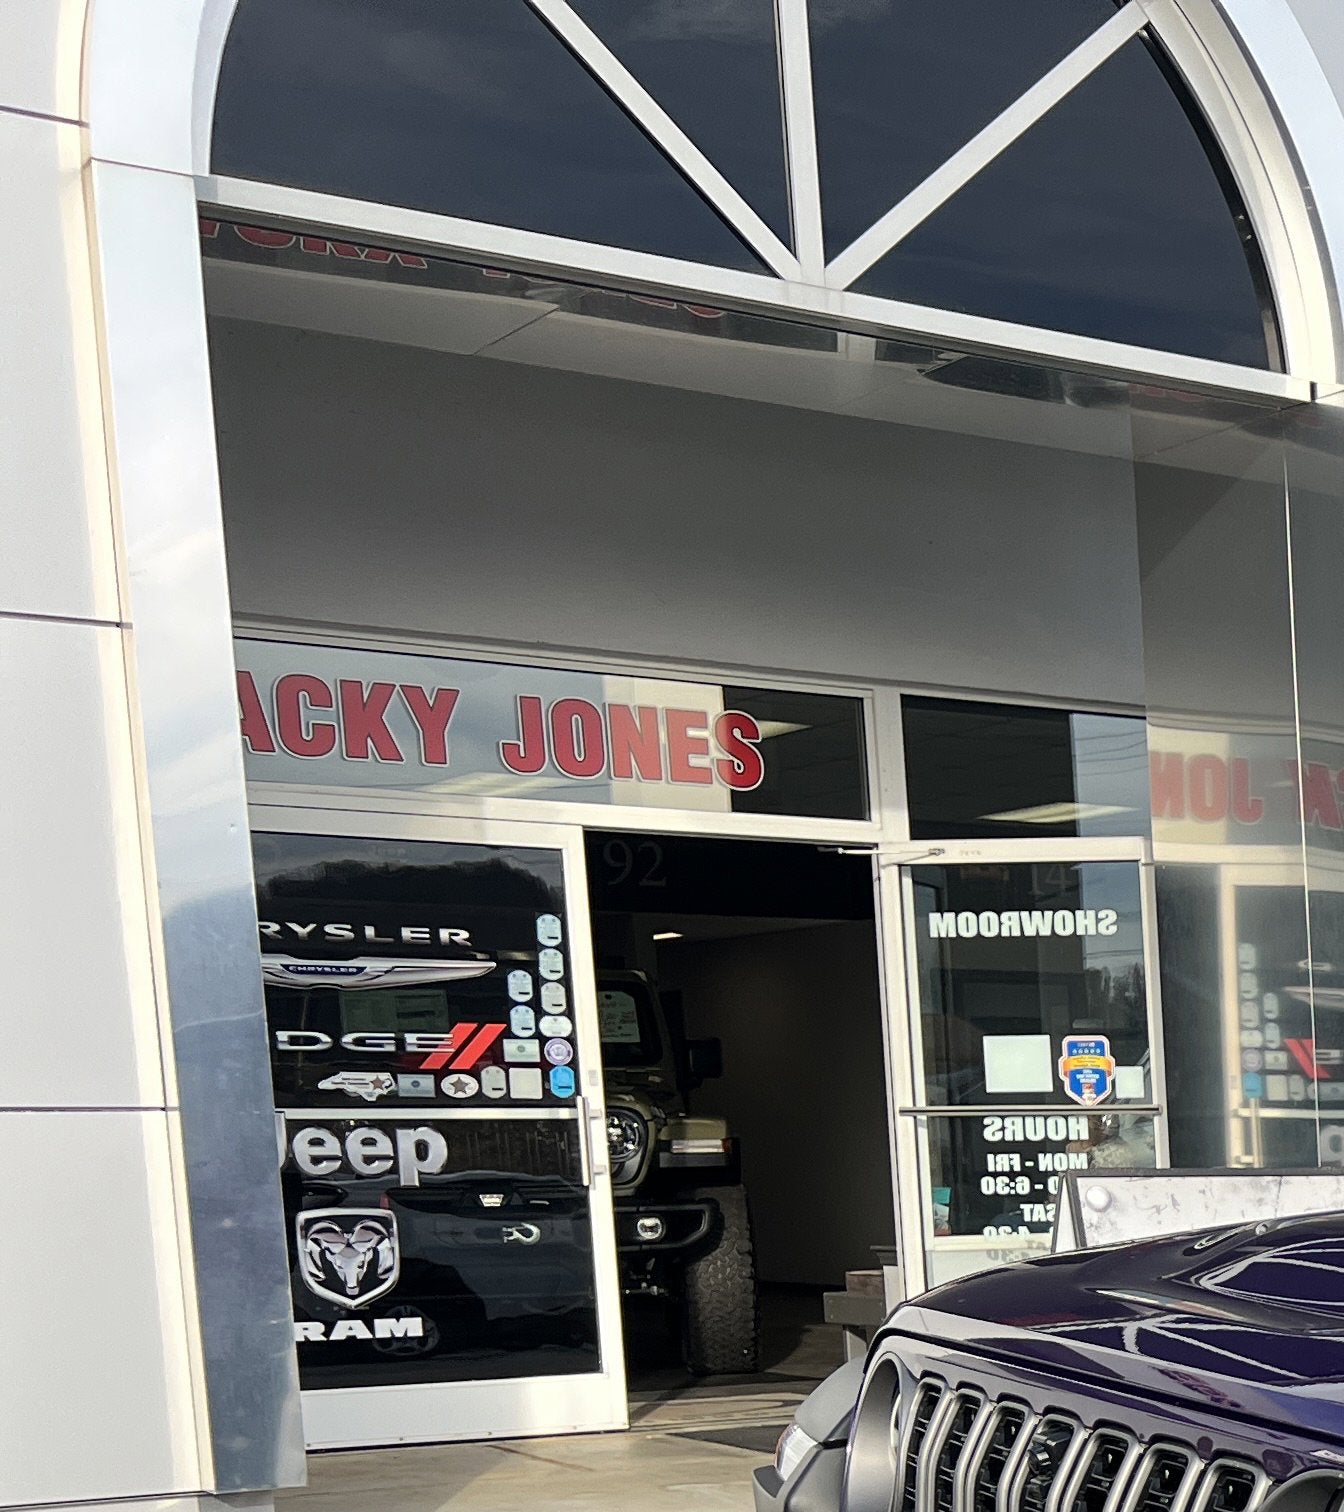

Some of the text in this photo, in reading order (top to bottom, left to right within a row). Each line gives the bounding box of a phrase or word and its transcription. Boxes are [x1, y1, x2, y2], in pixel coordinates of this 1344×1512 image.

[500, 695, 764, 791] JONES
[603, 839, 667, 887] 92
[258, 921, 472, 946] RYSLER
[276, 1031, 455, 1053] DGE
[294, 1317, 424, 1342] RAM
